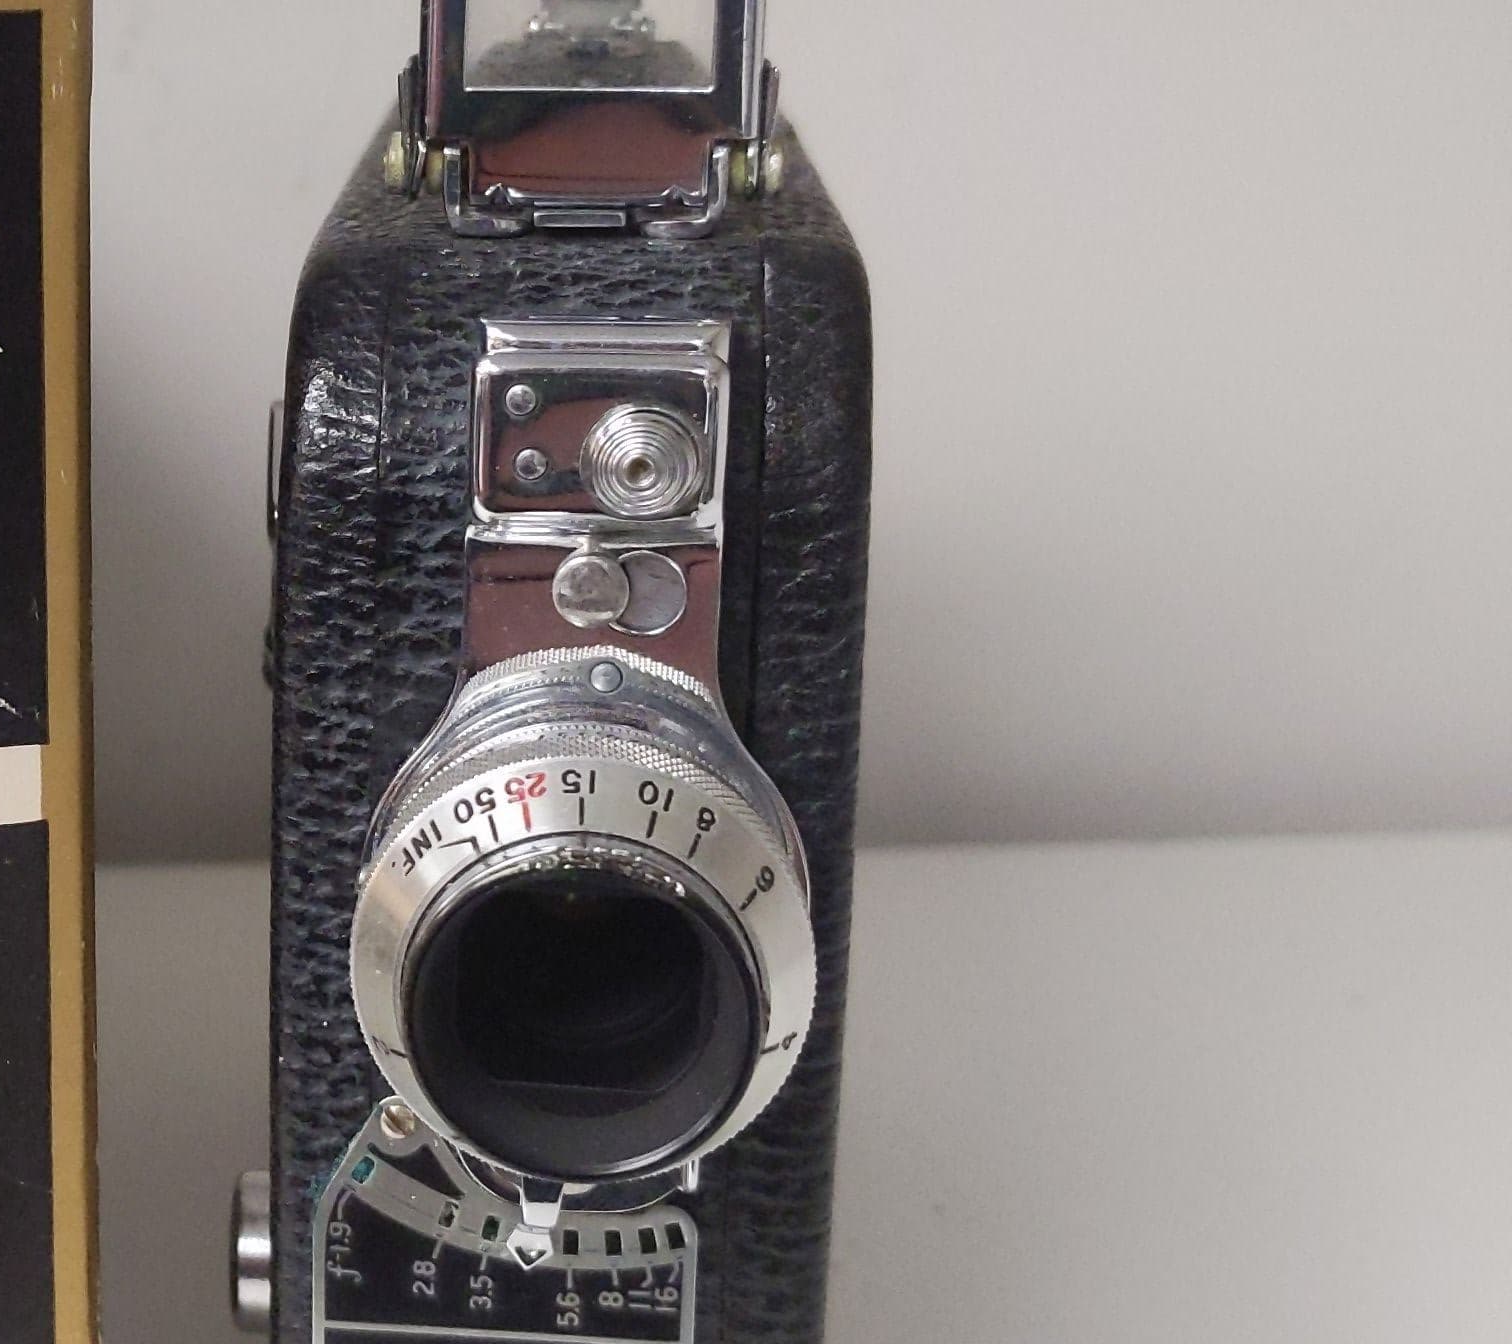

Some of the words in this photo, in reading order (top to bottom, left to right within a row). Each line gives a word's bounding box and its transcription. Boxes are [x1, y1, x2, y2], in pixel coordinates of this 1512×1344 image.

[503, 771, 548, 804] 25
[561, 768, 596, 795] 15
[638, 779, 674, 812] 10
[453, 786, 496, 824] 50
[695, 806, 717, 832] 8
[597, 1290, 624, 1308] 8
[654, 1286, 678, 1312] 16
